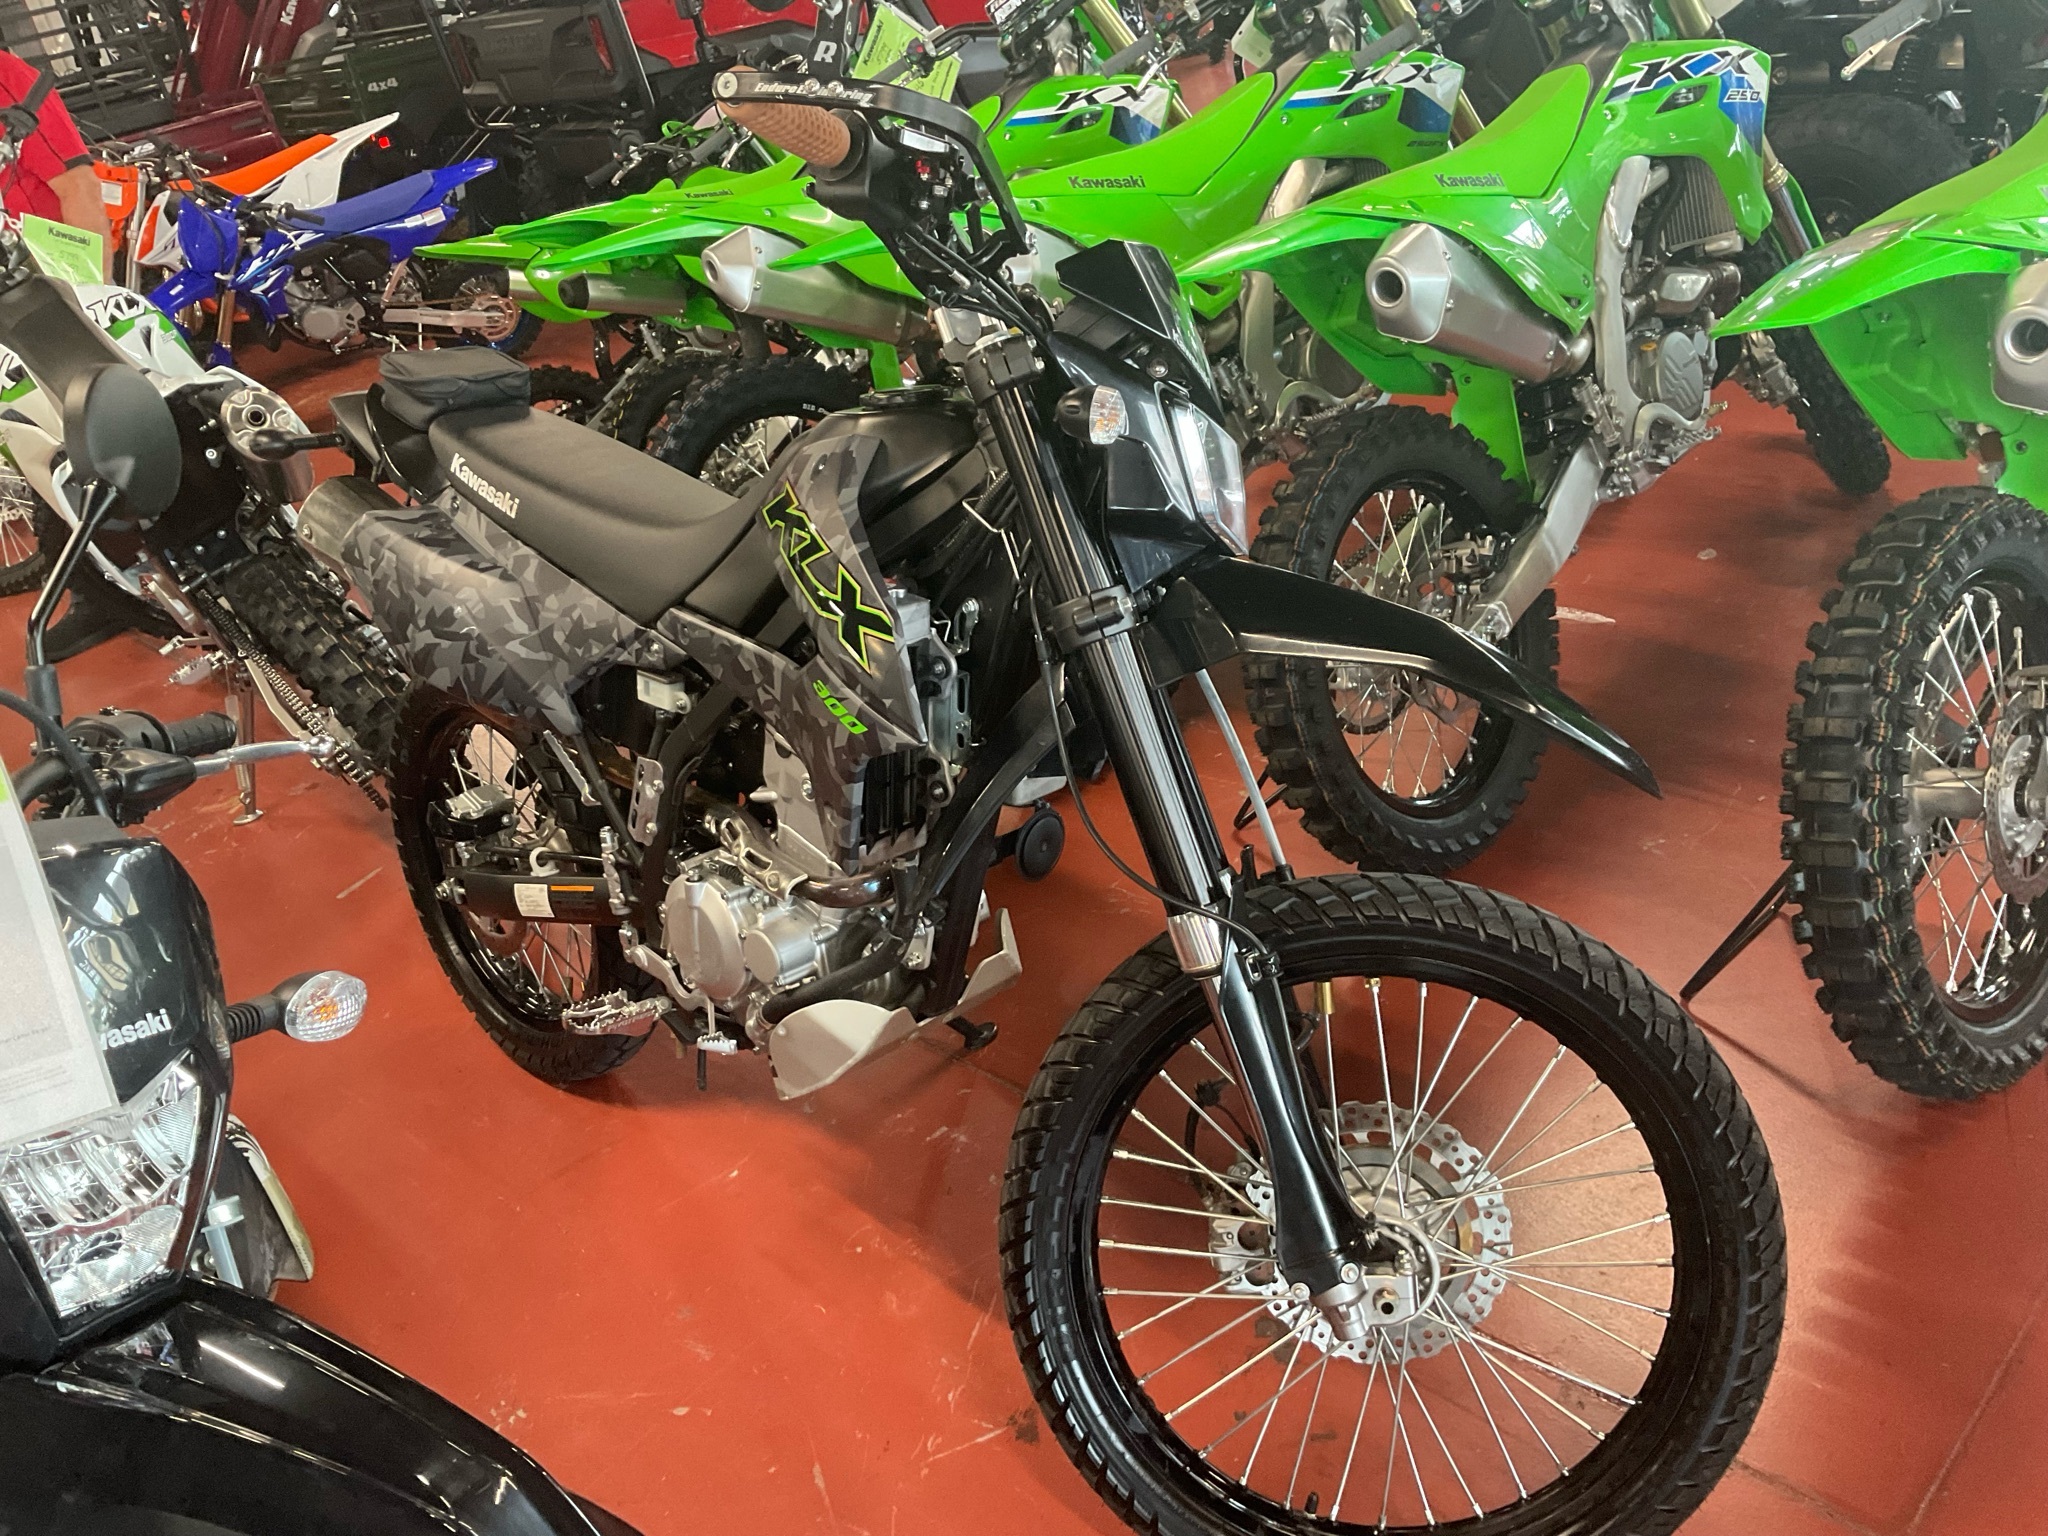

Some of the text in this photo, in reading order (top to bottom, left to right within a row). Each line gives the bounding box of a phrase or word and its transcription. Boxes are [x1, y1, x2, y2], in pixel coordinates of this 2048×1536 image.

[814, 41, 837, 63] R
[1629, 49, 1760, 92] KX
[367, 77, 398, 92] 4x4
[1724, 89, 1761, 102] 250
[1068, 175, 1146, 188] Kawasaki
[1434, 173, 1505, 187] Kawasaki
[684, 189, 734, 198] Kawasaki
[48, 226, 91, 246] Kawasaki
[450, 452, 520, 519] Kawasaki
[762, 481, 895, 677] KLX
[812, 679, 868, 735] 300
[100, 1008, 172, 1050] asaki
